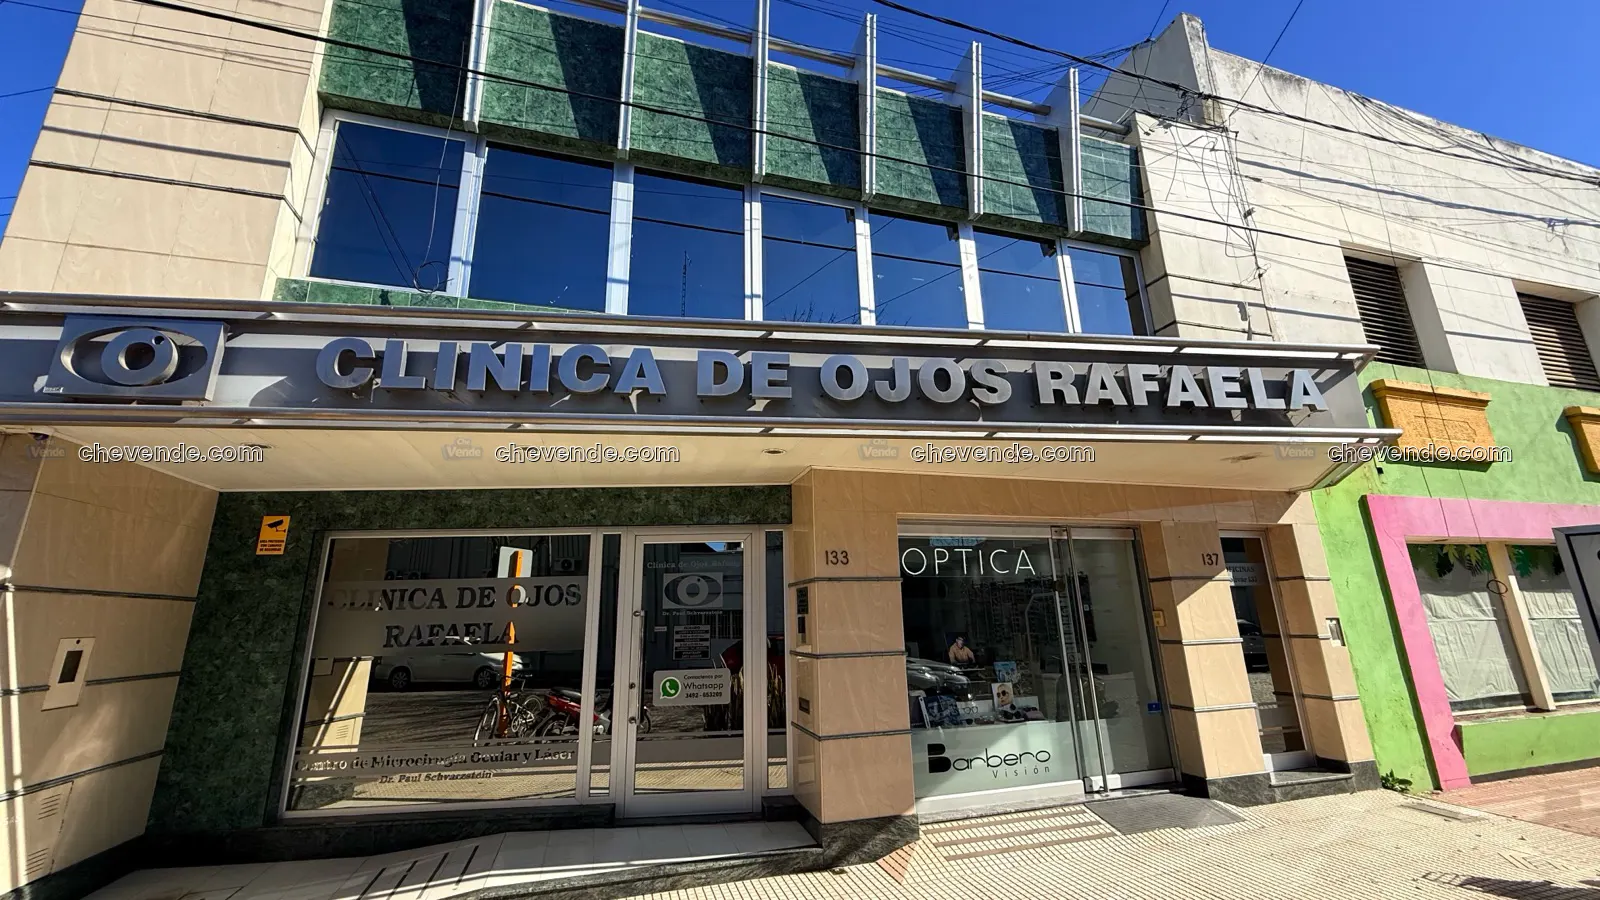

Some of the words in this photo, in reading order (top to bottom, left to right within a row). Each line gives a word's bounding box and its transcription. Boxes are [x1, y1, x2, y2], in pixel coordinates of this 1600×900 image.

[315, 337, 667, 394] CLINICA
[696, 350, 793, 399] DE
[819, 353, 1012, 404] OJOS
[1032, 361, 1329, 411] RAFAELA
[825, 550, 849, 565] 133
[901, 547, 1036, 576] OPTICA
[1201, 553, 1219, 566] 137
[328, 587, 447, 611] CLINICA
[456, 586, 496, 609] DE
[506, 583, 582, 608] OJOS
[383, 622, 519, 648] RAFAELA
[683, 682, 724, 690] Whatsapp
[350, 756, 368, 769] de
[470, 748, 519, 763] Ocular
[522, 752, 532, 765] y
[534, 748, 576, 762] Láser
[927, 743, 1051, 774] Barbero
[378, 774, 395, 784] Dr.
[398, 773, 421, 783] Paul
[992, 764, 1050, 779] Visión
